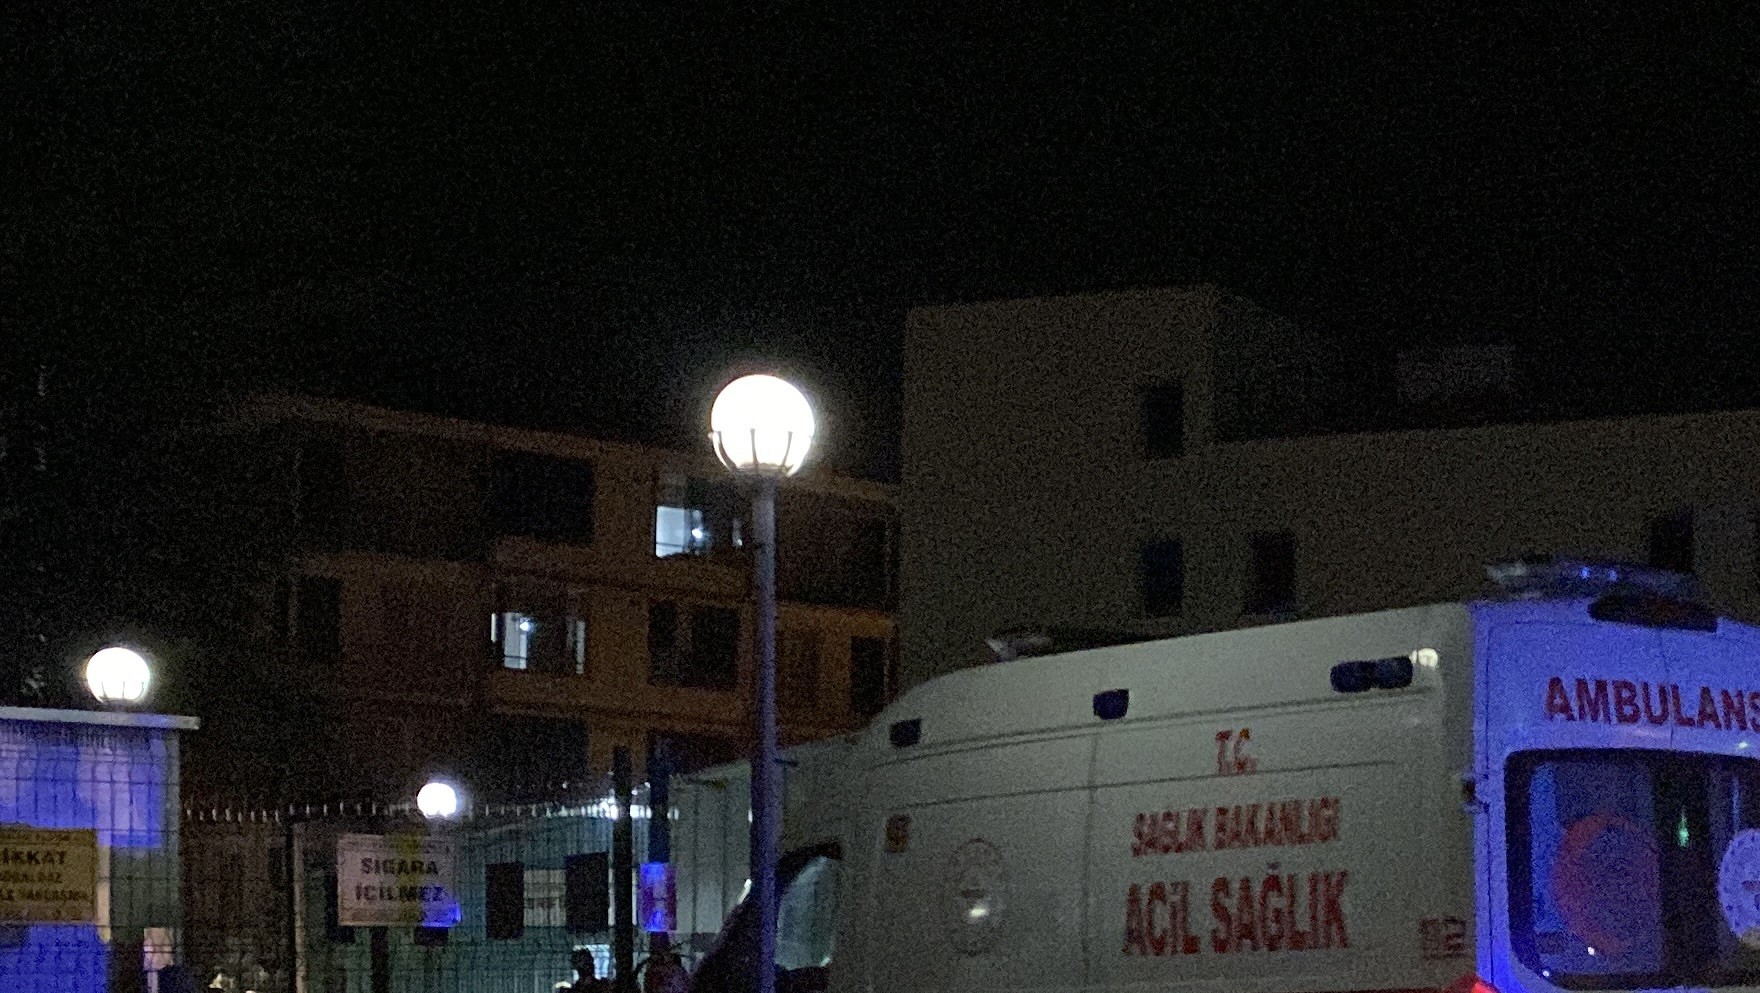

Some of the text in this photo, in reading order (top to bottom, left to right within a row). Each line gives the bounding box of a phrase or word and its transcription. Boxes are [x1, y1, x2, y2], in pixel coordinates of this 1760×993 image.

[1, 847, 67, 864] İKKAT
[1122, 880, 1199, 956] ACİL
[1211, 861, 1349, 954] SAĞLIK
